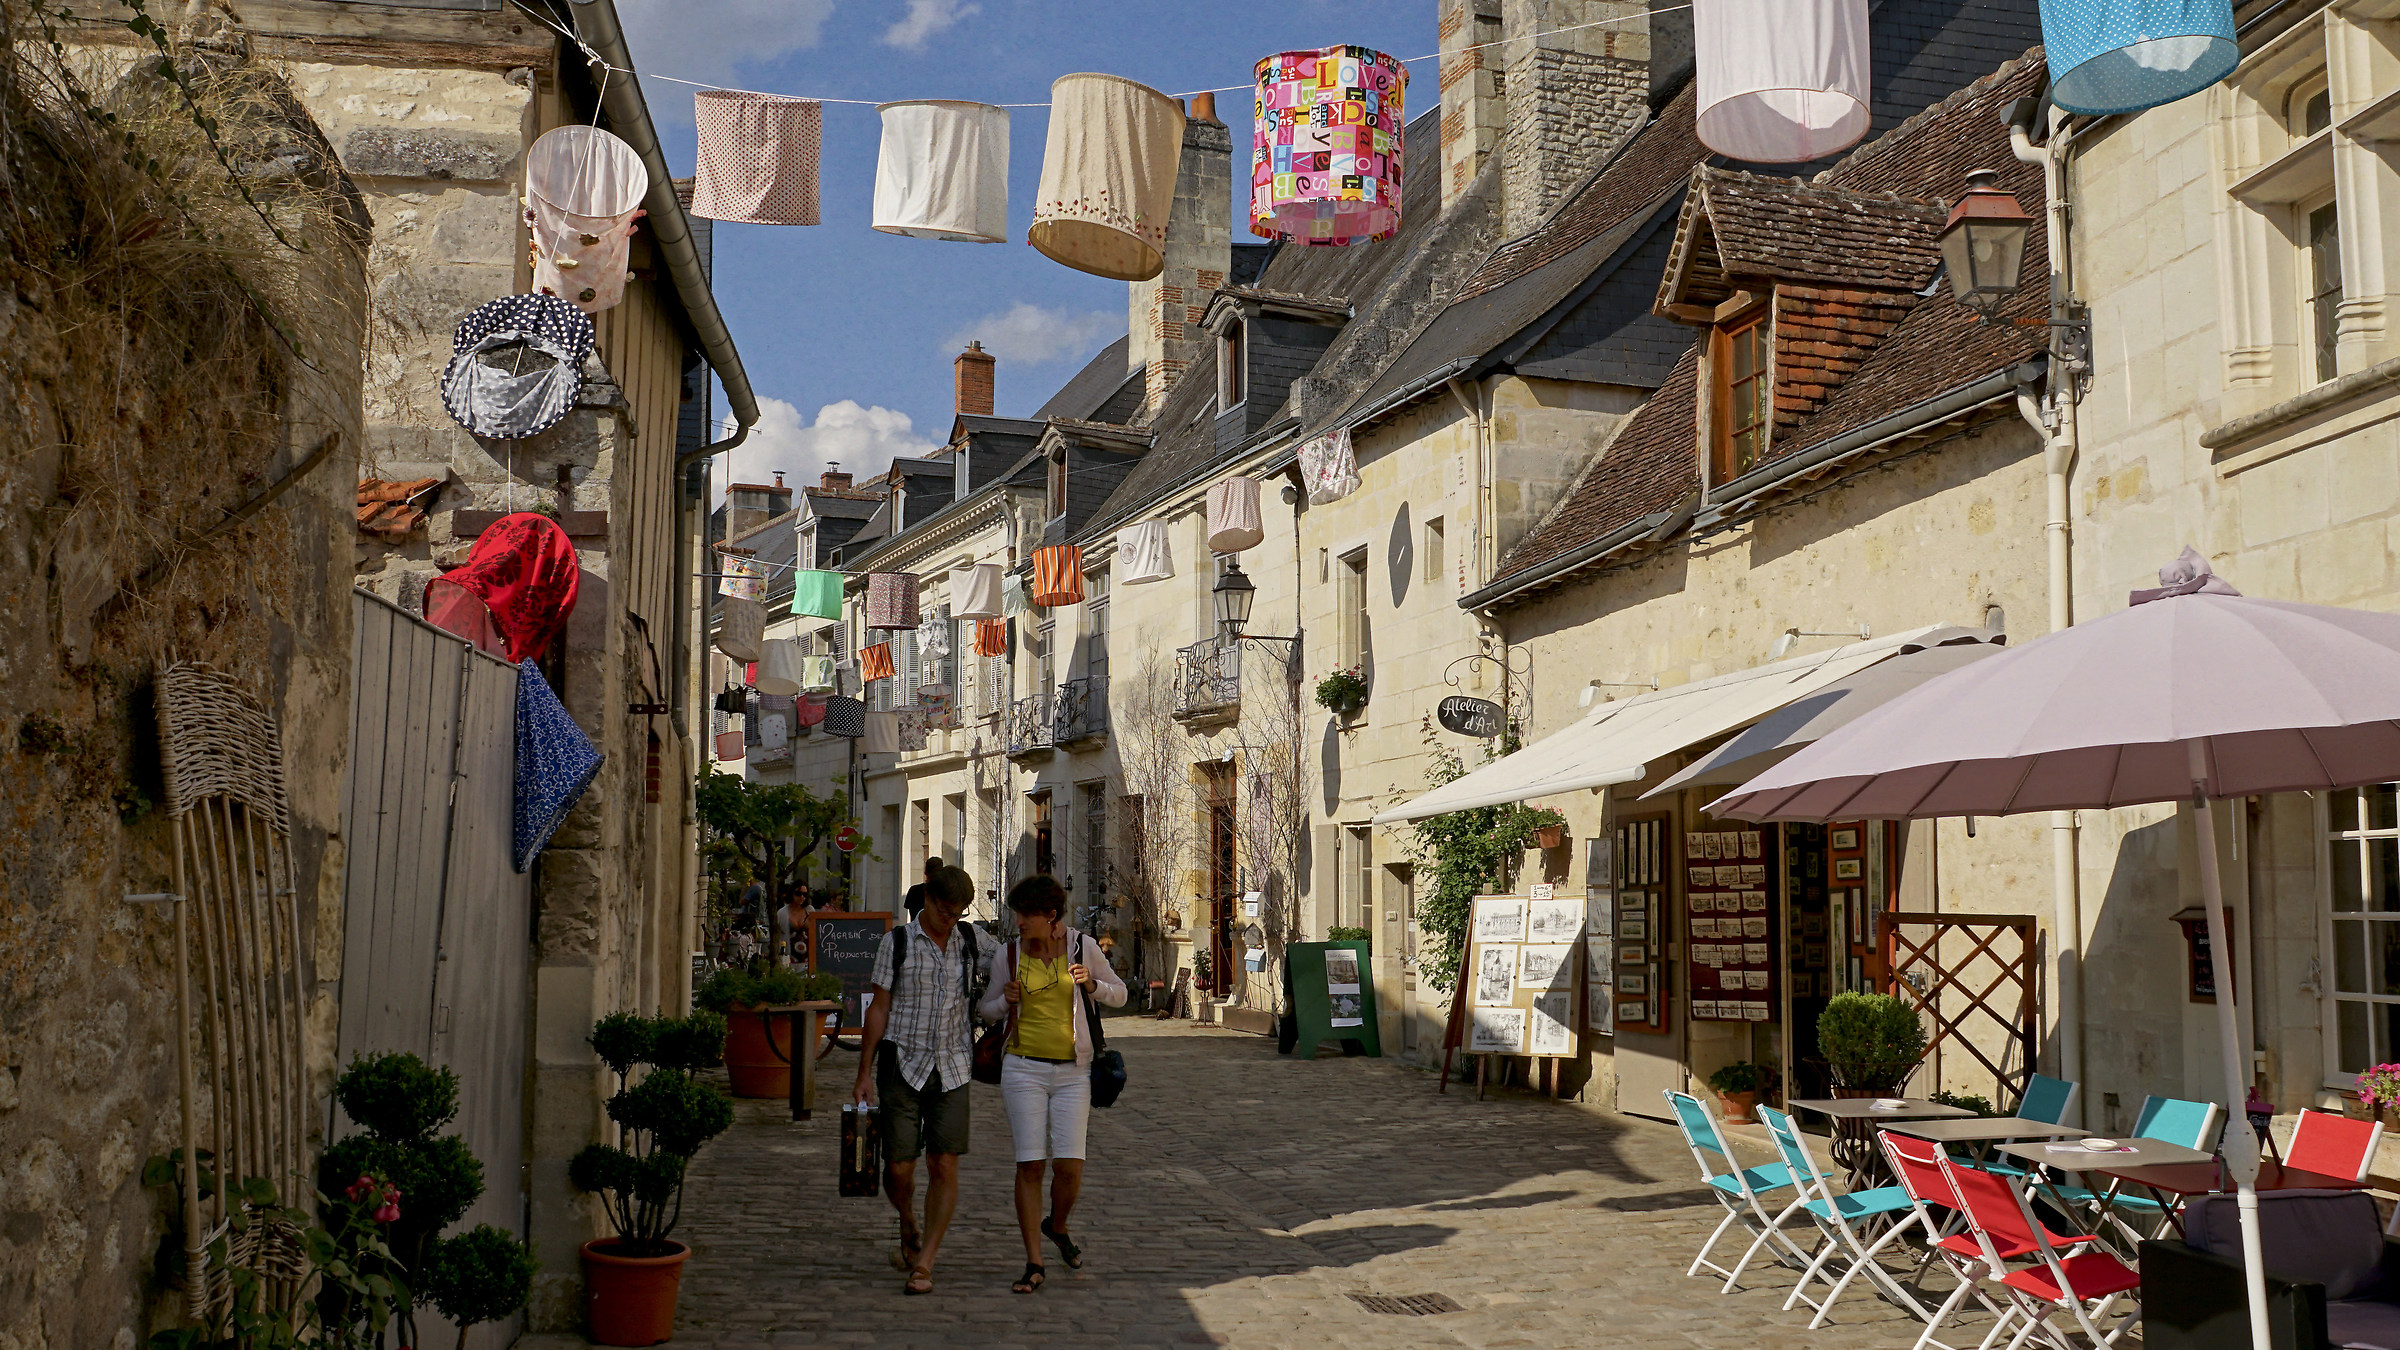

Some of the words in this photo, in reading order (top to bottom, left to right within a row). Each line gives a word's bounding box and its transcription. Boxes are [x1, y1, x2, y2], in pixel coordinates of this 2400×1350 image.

[1442, 698, 1489, 718] Atelier
[1462, 715, 1498, 734] d'Art
[823, 941, 875, 962] PRODUCTEU
